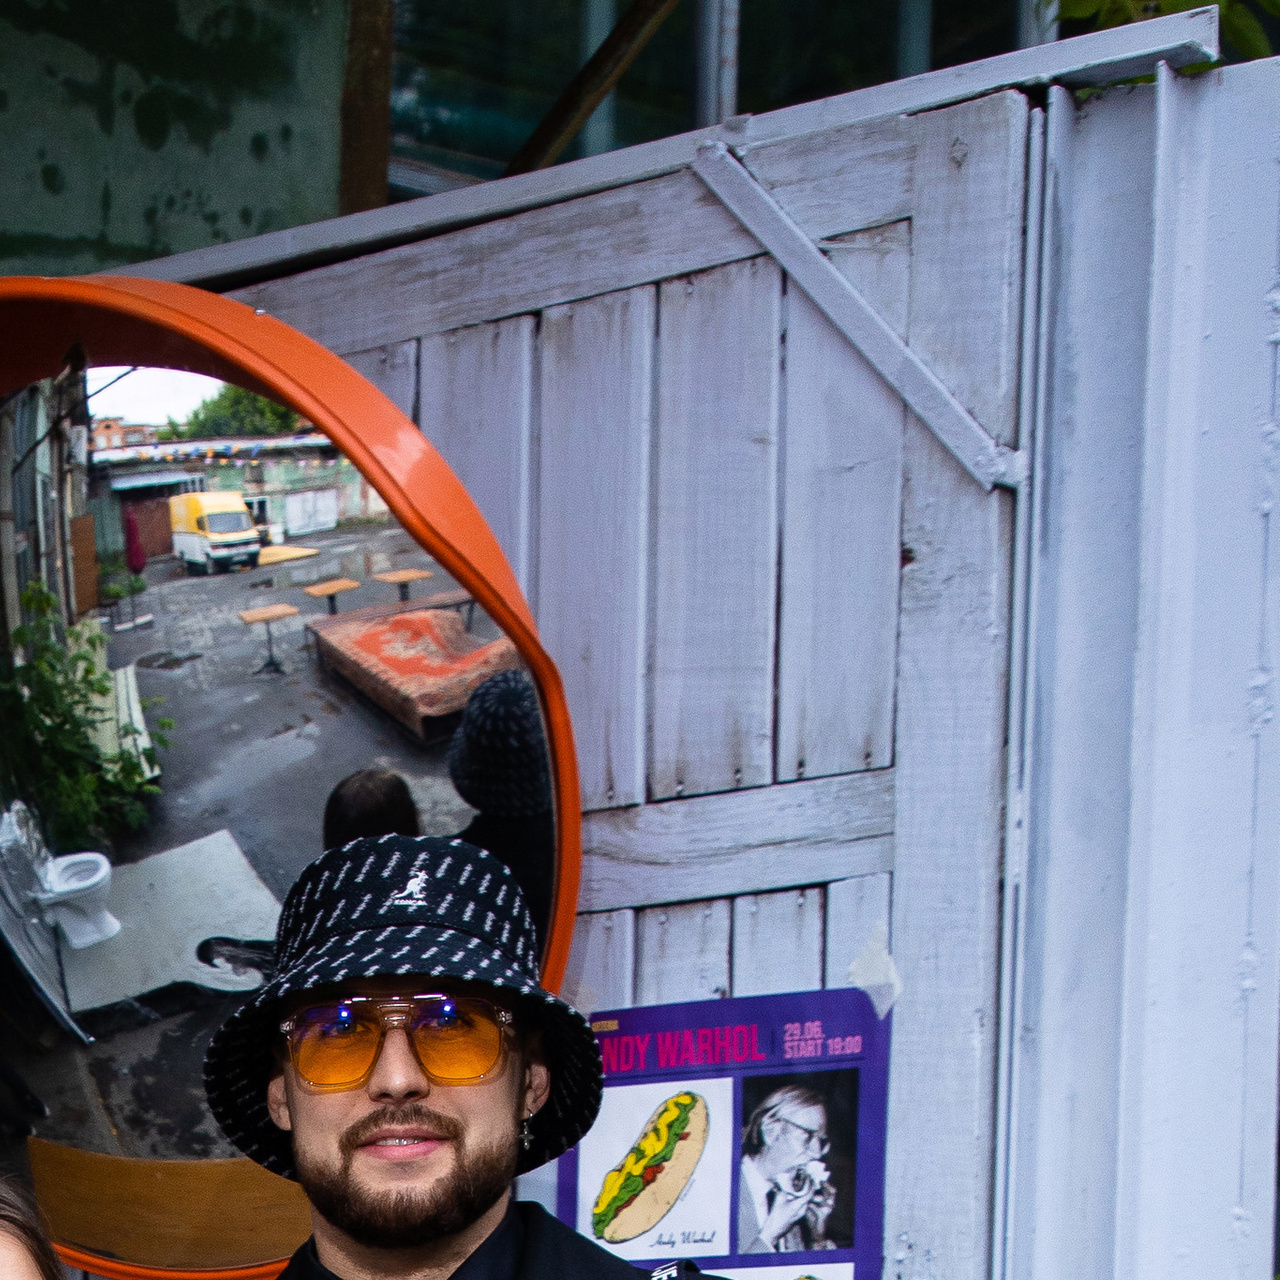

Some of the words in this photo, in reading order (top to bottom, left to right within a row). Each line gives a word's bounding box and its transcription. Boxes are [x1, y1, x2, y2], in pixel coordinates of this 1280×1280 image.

[602, 1033, 651, 1073] NDY
[656, 1024, 766, 1069] WARHOL
[783, 1039, 823, 1058] START
